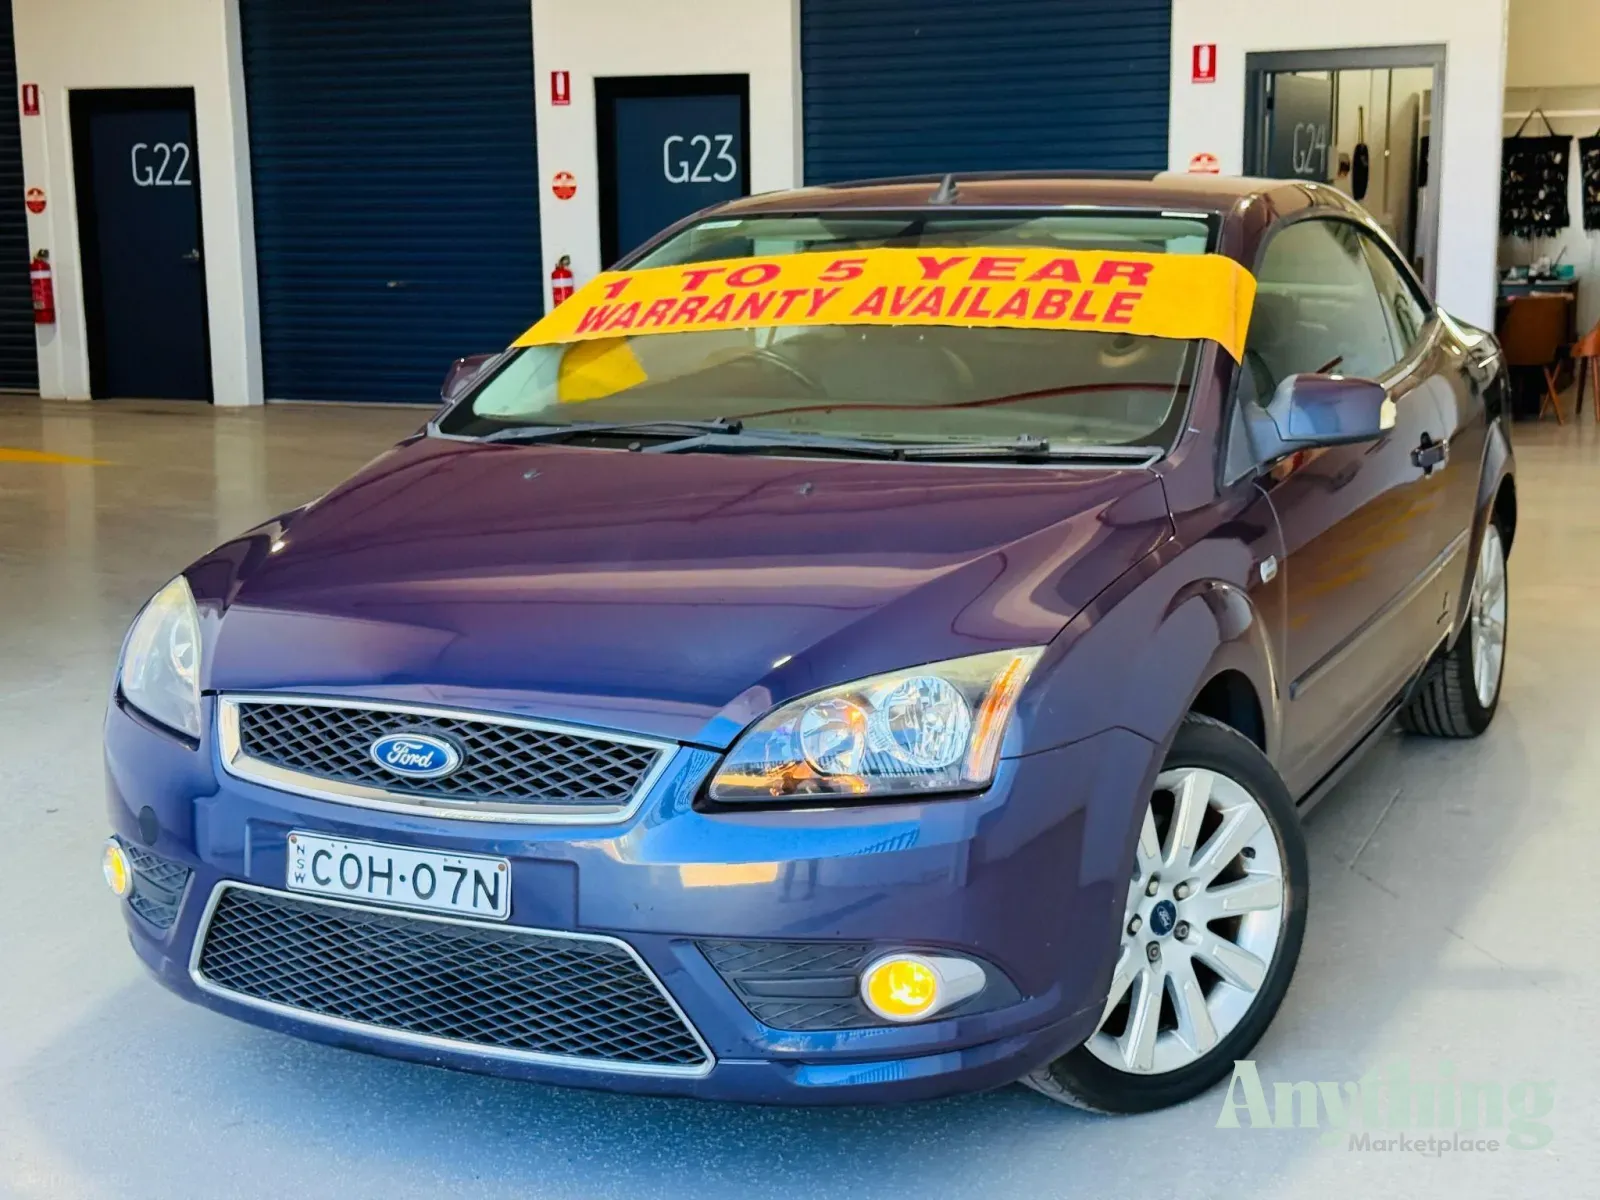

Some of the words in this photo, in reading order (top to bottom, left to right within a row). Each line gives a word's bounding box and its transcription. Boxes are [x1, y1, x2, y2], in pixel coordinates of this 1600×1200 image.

[131, 142, 192, 187] G22
[663, 134, 737, 184] G23
[1292, 123, 1327, 174] G24
[603, 277, 633, 299] 1
[681, 263, 781, 292] TO
[817, 258, 868, 282] 5
[917, 256, 1155, 286] YEAR
[573, 287, 844, 334] WARRANTY
[849, 285, 1144, 324] AVAILABLE
[386, 741, 435, 768] Ford
